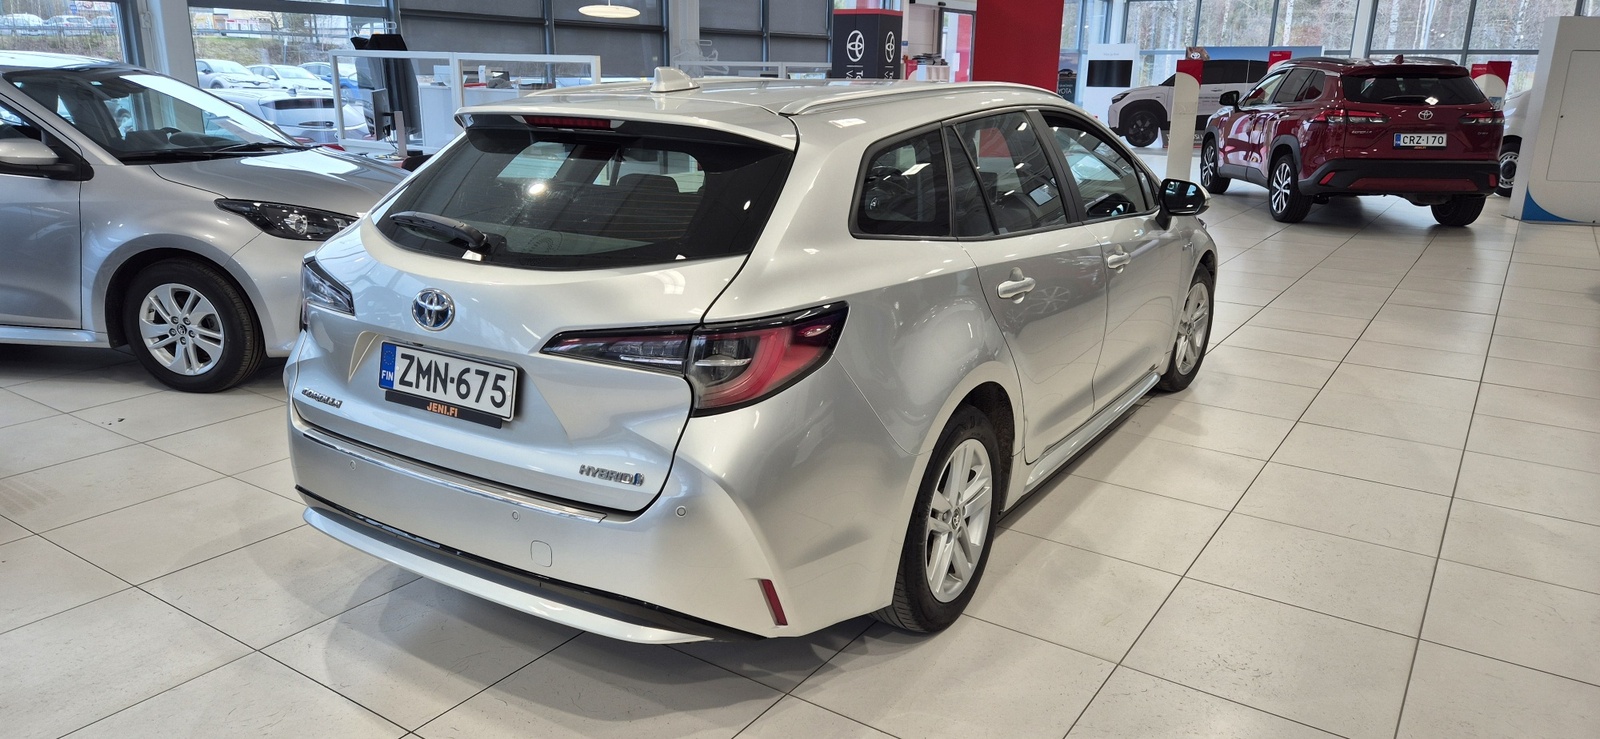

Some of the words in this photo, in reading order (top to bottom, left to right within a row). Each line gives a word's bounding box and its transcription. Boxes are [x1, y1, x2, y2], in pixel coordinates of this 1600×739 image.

[1402, 136, 1444, 145] CRZ-170
[381, 370, 394, 381] FIN
[399, 353, 507, 409] ZMN-675
[426, 402, 459, 418] JENI.FI
[579, 464, 633, 484] HYBRID
